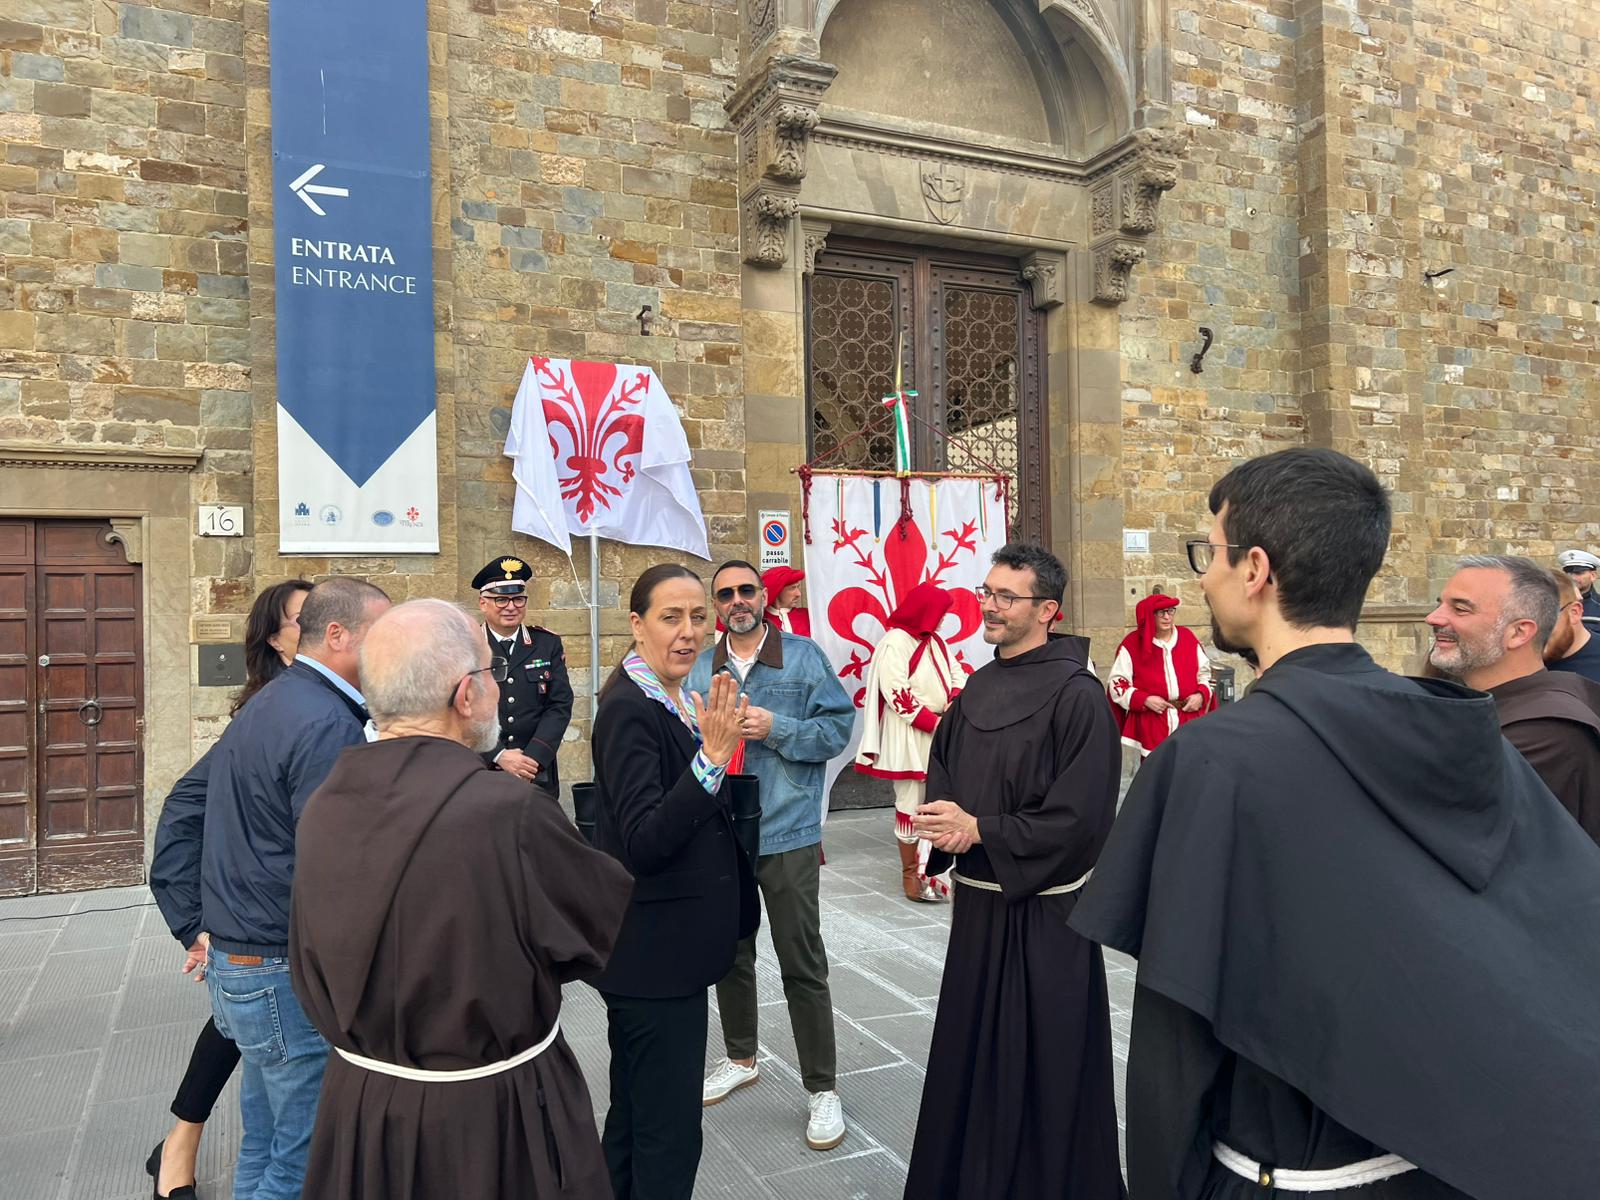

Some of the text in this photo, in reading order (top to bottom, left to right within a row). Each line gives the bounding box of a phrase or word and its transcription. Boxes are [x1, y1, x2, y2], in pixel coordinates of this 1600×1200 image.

[291, 237, 395, 265] ENTRATA
[292, 266, 417, 294] ENTRANCE
[207, 510, 235, 531] 16
